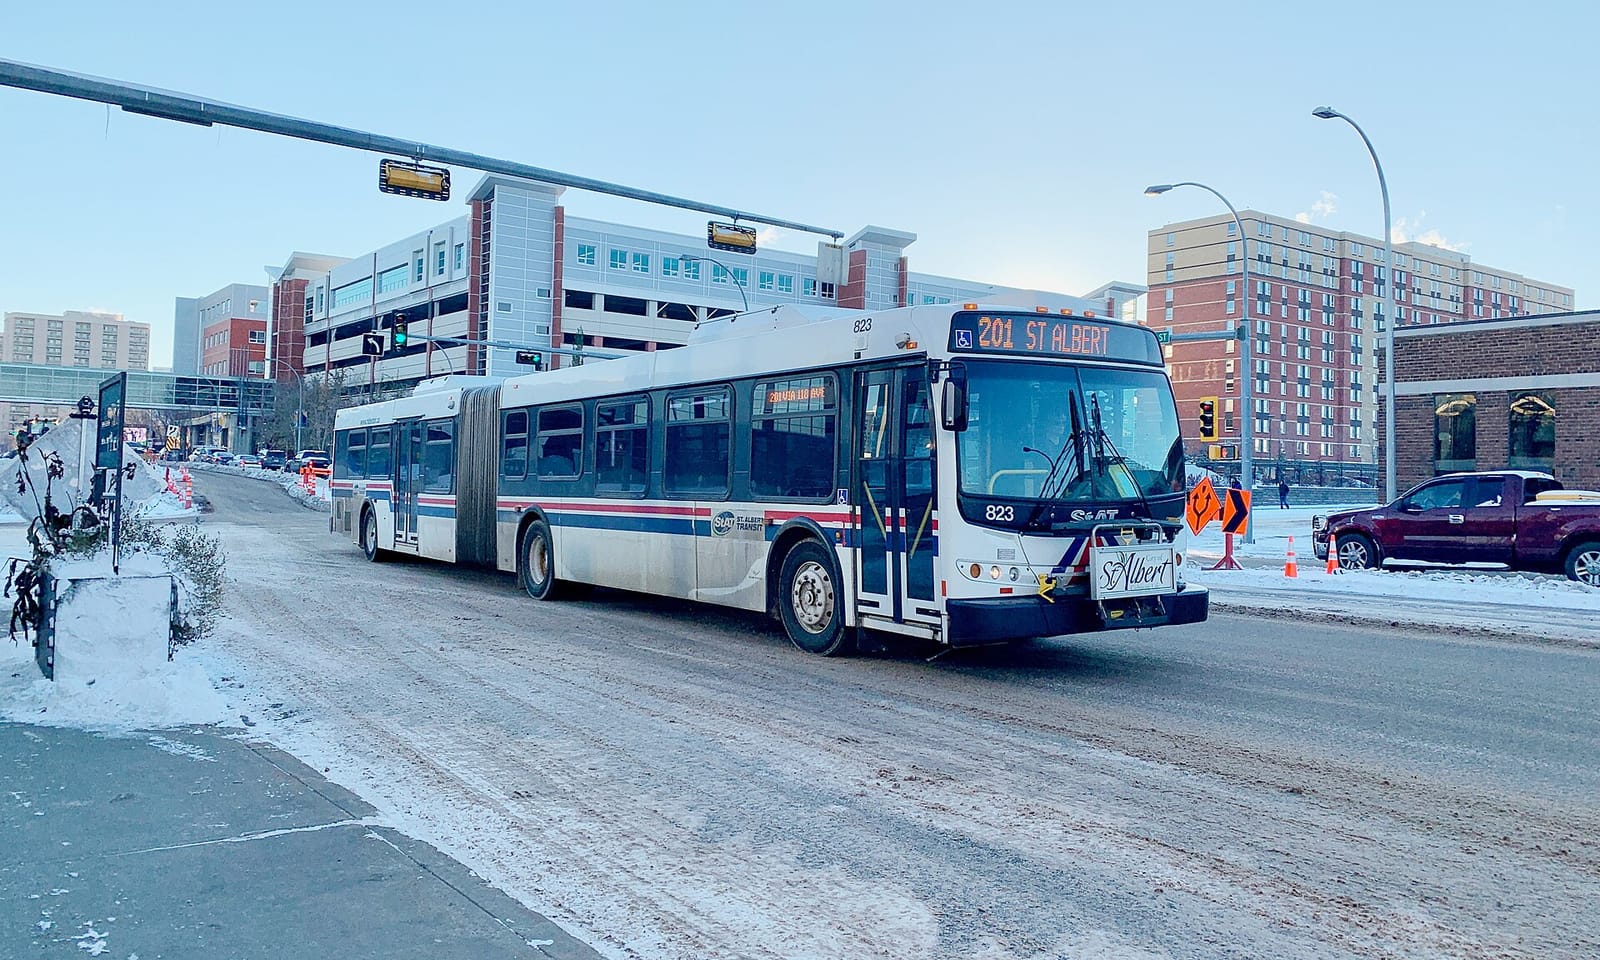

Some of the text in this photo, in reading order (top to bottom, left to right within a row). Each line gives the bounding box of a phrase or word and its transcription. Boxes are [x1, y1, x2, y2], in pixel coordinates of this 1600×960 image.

[853, 317, 872, 333] 823
[978, 316, 1110, 355] 201 ST ALBERT
[1158, 332, 1167, 342] ST
[745, 516, 764, 524] ALBERT
[985, 504, 1014, 521] 823
[736, 522, 763, 531] TRANSIT
[1106, 552, 1173, 591] Albert
